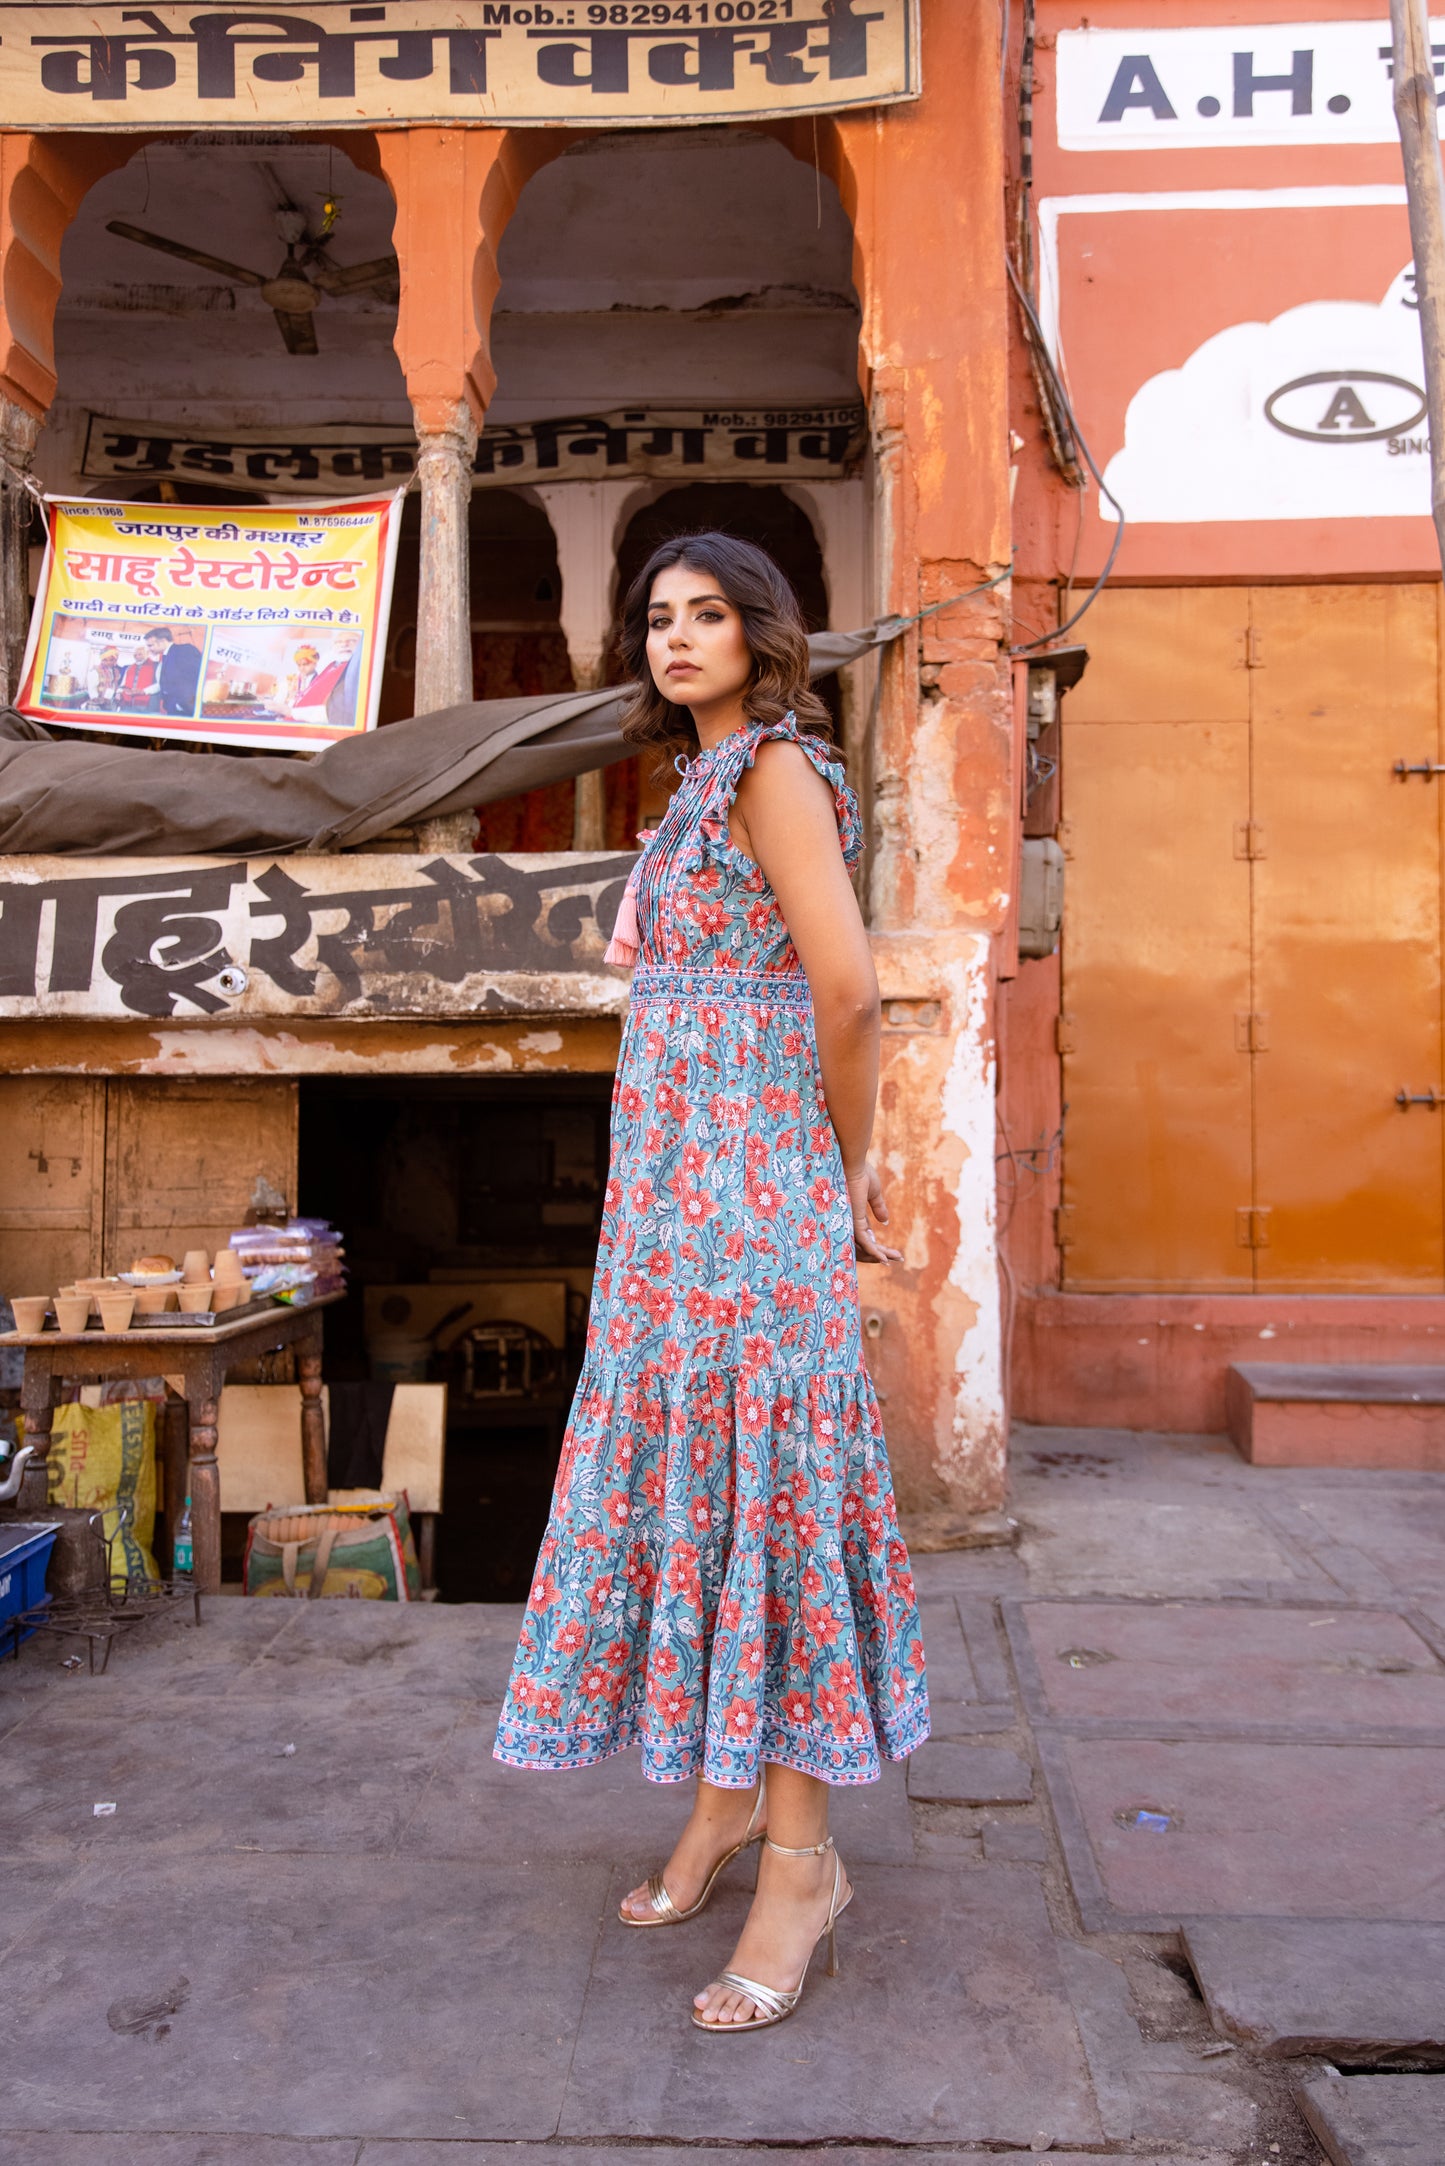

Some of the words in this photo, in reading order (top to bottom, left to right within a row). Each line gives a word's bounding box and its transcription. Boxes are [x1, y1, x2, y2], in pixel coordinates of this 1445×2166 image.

[483, 4, 575, 25] Mob.:
[587, 0, 795, 25] 9829410021
[31, 7, 502, 100] केनिंग
[1098, 49, 1351, 122] A.H.
[1317, 386, 1376, 429] A
[114, 522, 200, 541] जयपुर
[204, 524, 240, 541] की
[245, 530, 326, 548] मशहूर
[67, 550, 162, 596] साहू
[169, 546, 363, 590] रेस्टोरेन्ट
[62, 599, 104, 612] शादी
[107, 603, 121, 613] व
[125, 603, 183, 617] पार्टियों
[185, 605, 204, 619] के
[207, 608, 255, 620] ऑर्डर
[257, 607, 290, 620] लिये
[294, 608, 334, 621] जाते
